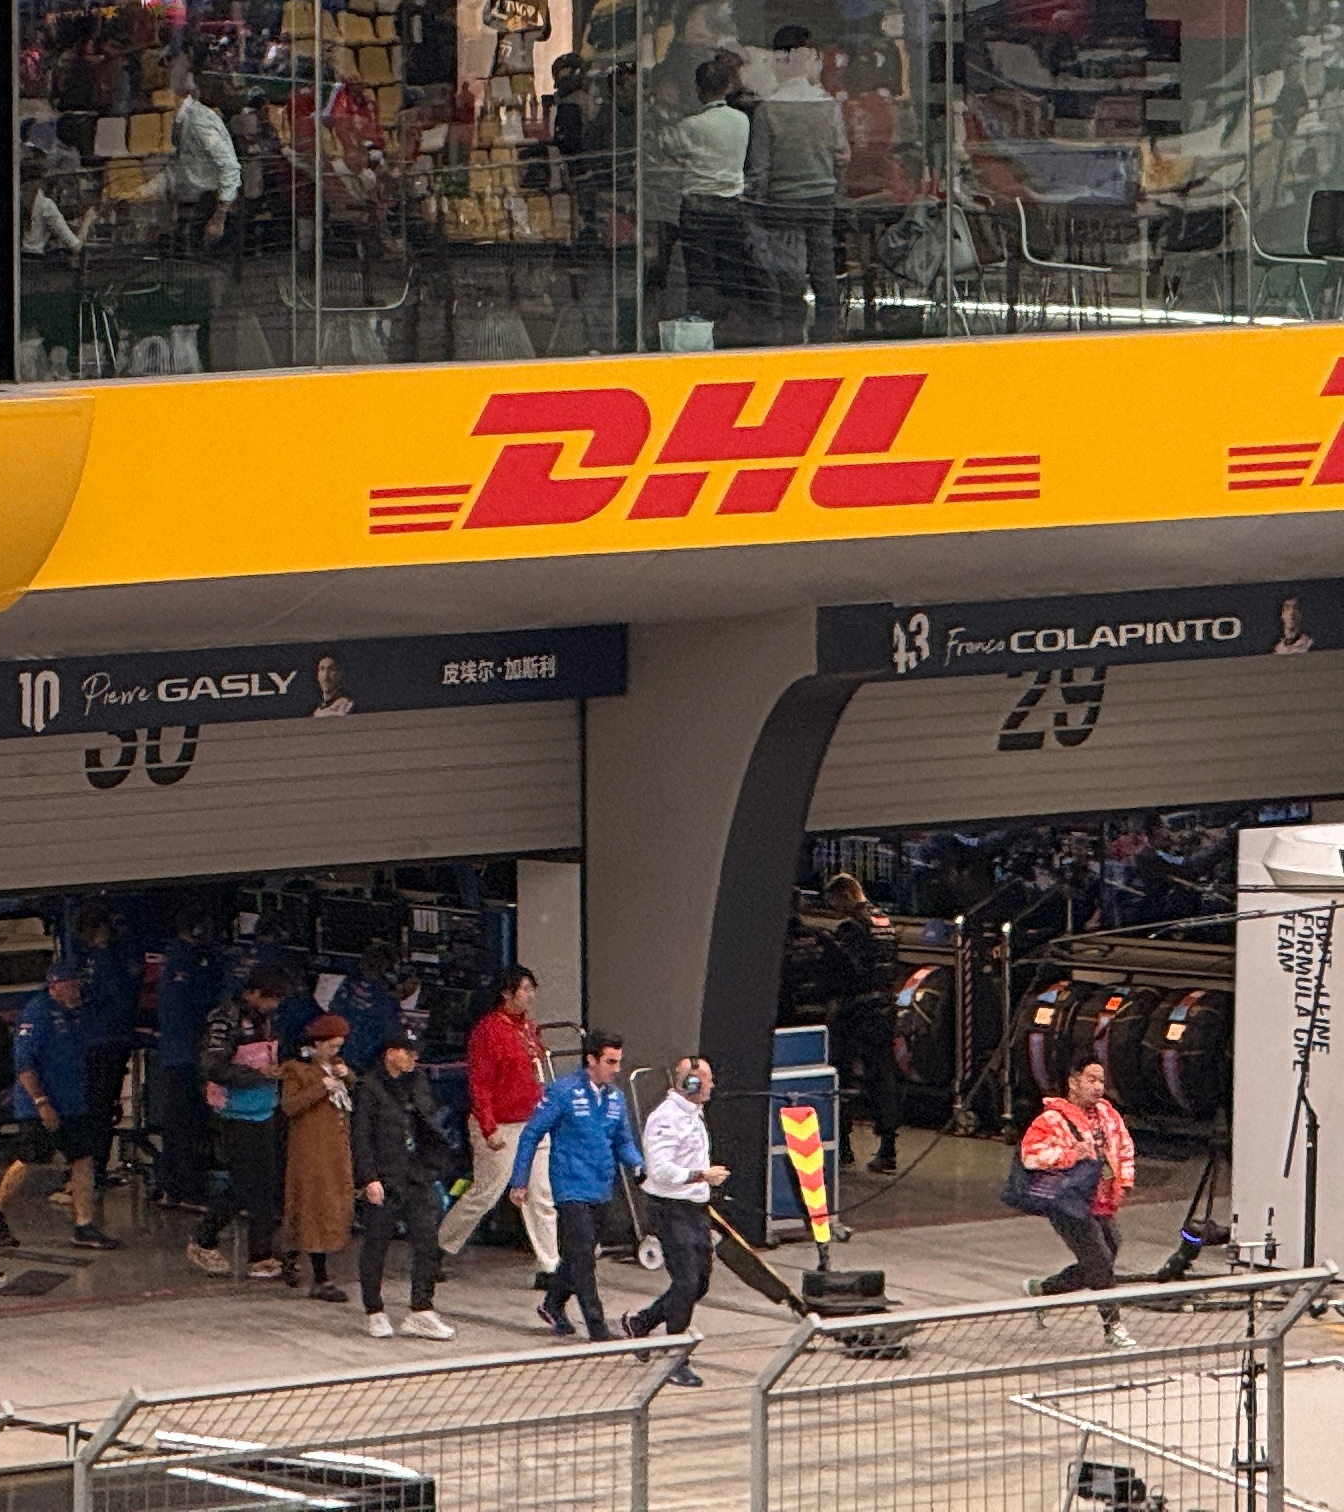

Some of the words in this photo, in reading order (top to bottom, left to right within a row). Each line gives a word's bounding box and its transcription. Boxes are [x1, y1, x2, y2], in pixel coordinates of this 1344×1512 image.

[459, 373, 955, 531] DHL
[1010, 616, 1242, 654] COLAPINTO
[19, 669, 60, 733] 10
[81, 671, 152, 717] Pierre
[157, 670, 297, 702] GASLY
[997, 666, 1109, 752] 29
[1278, 912, 1296, 973] TEAM
[1295, 912, 1315, 1018] FORMULA
